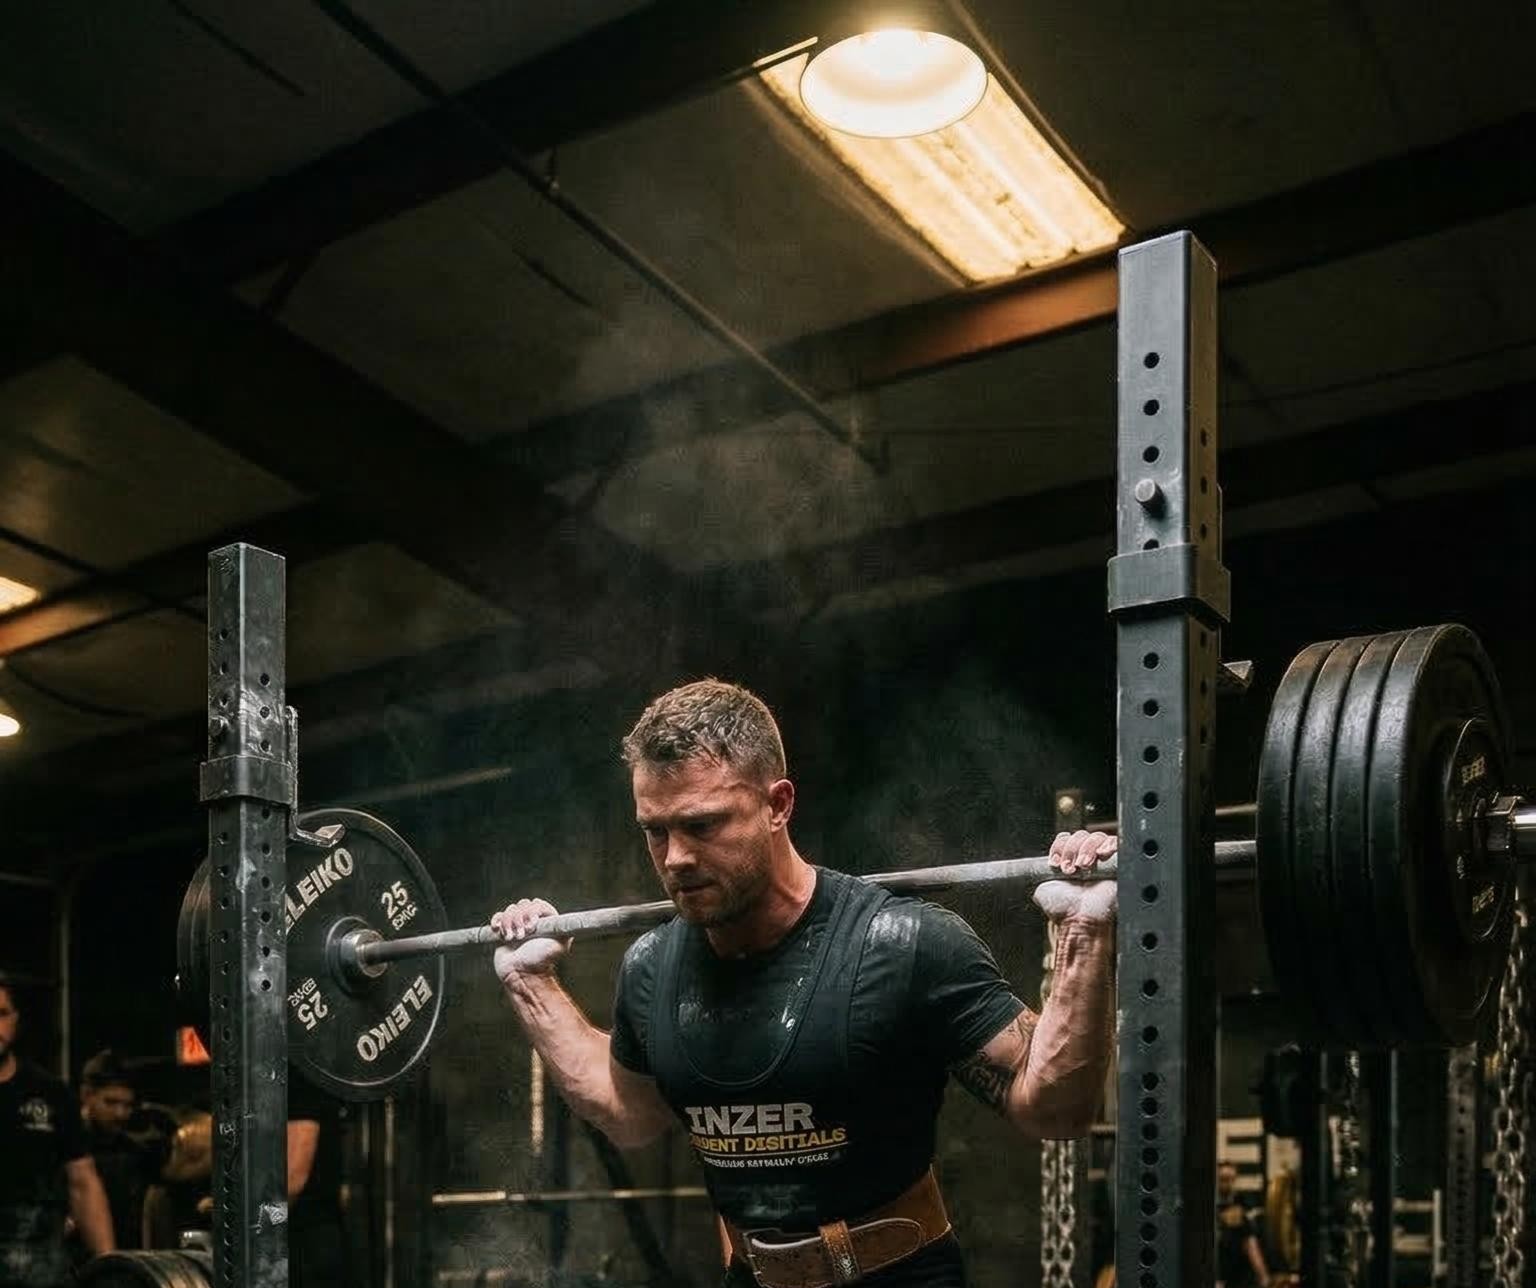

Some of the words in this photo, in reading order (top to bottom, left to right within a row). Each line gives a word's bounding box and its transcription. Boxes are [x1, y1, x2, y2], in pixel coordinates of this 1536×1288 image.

[381, 880, 408, 919] 25
[297, 990, 328, 1030] 25
[356, 974, 433, 1062] ELEIKO
[685, 1102, 815, 1135] INZER
